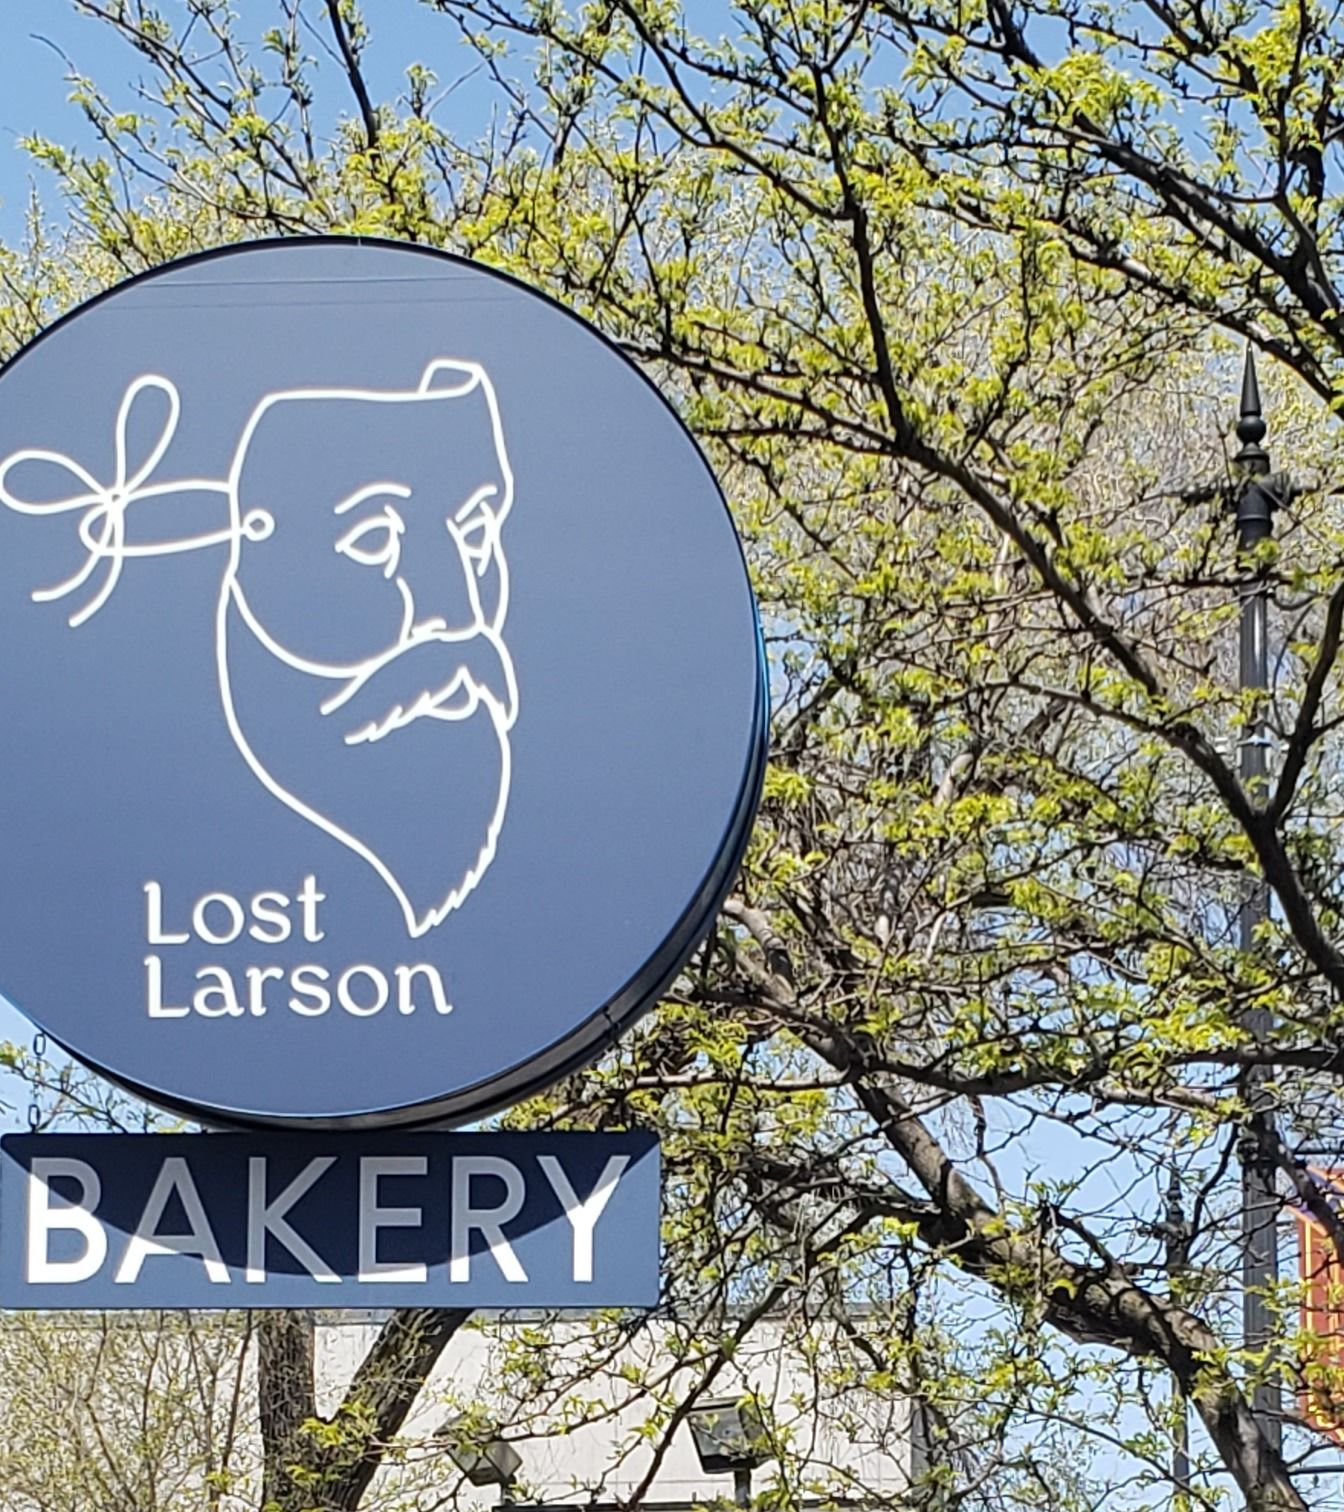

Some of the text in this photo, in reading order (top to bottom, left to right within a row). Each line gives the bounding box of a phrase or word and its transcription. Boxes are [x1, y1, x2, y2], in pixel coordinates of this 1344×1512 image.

[143, 873, 327, 944] Lost
[143, 953, 454, 1019] Larson
[26, 1155, 632, 1285] BAKERY
